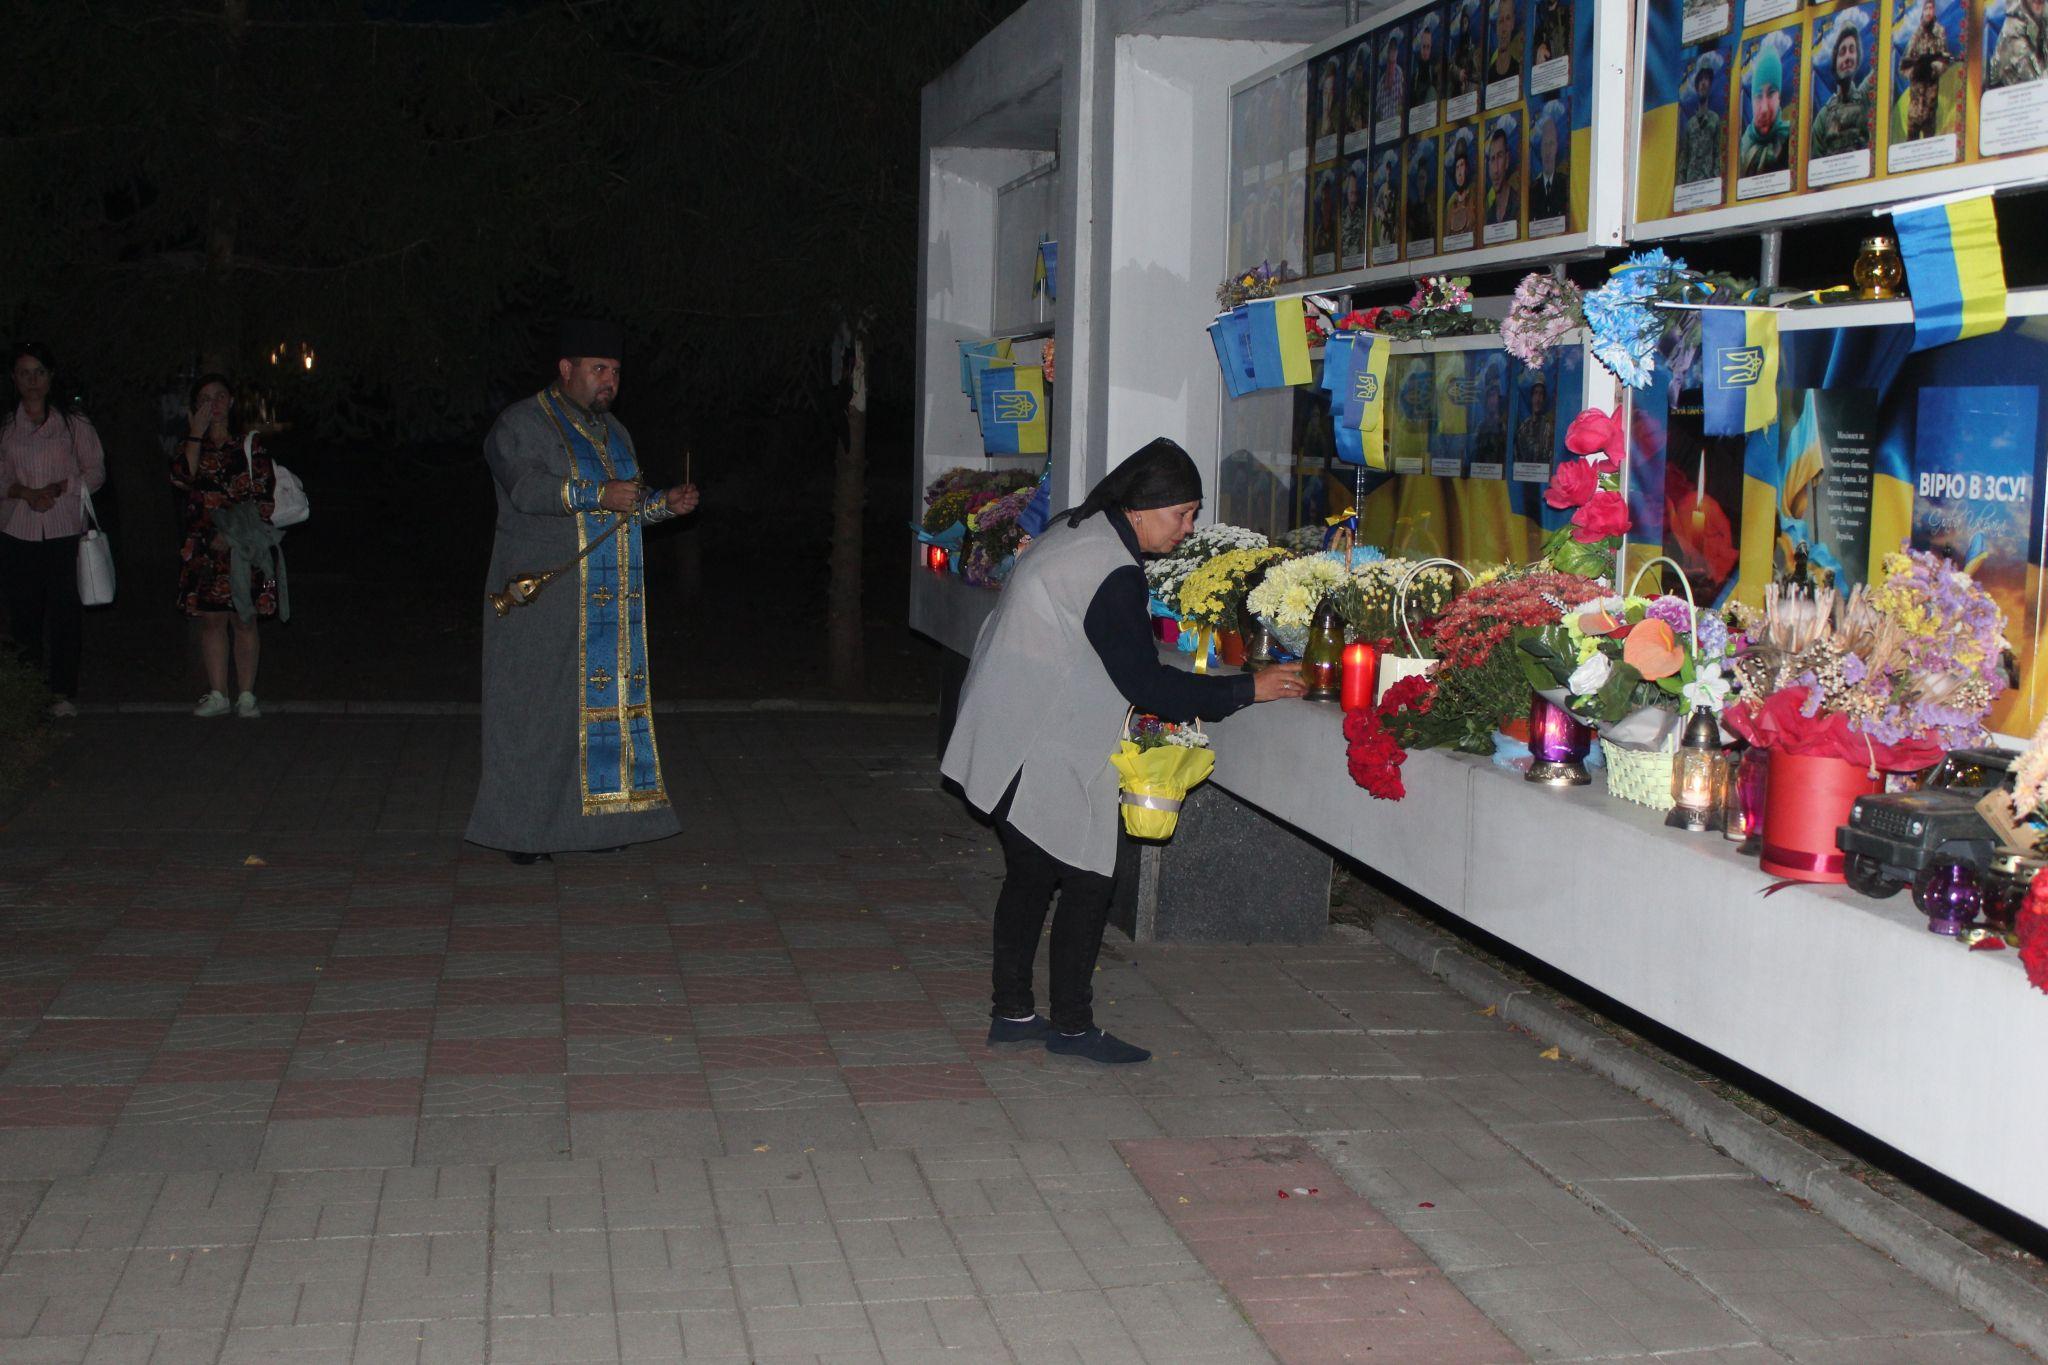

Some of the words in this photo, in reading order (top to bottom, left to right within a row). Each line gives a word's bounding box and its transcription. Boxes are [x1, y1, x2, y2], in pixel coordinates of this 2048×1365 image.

[1920, 472, 1966, 499] ВІРЮ
[1969, 475, 1981, 500] В
[1984, 475, 2027, 503] ЗСУ!
